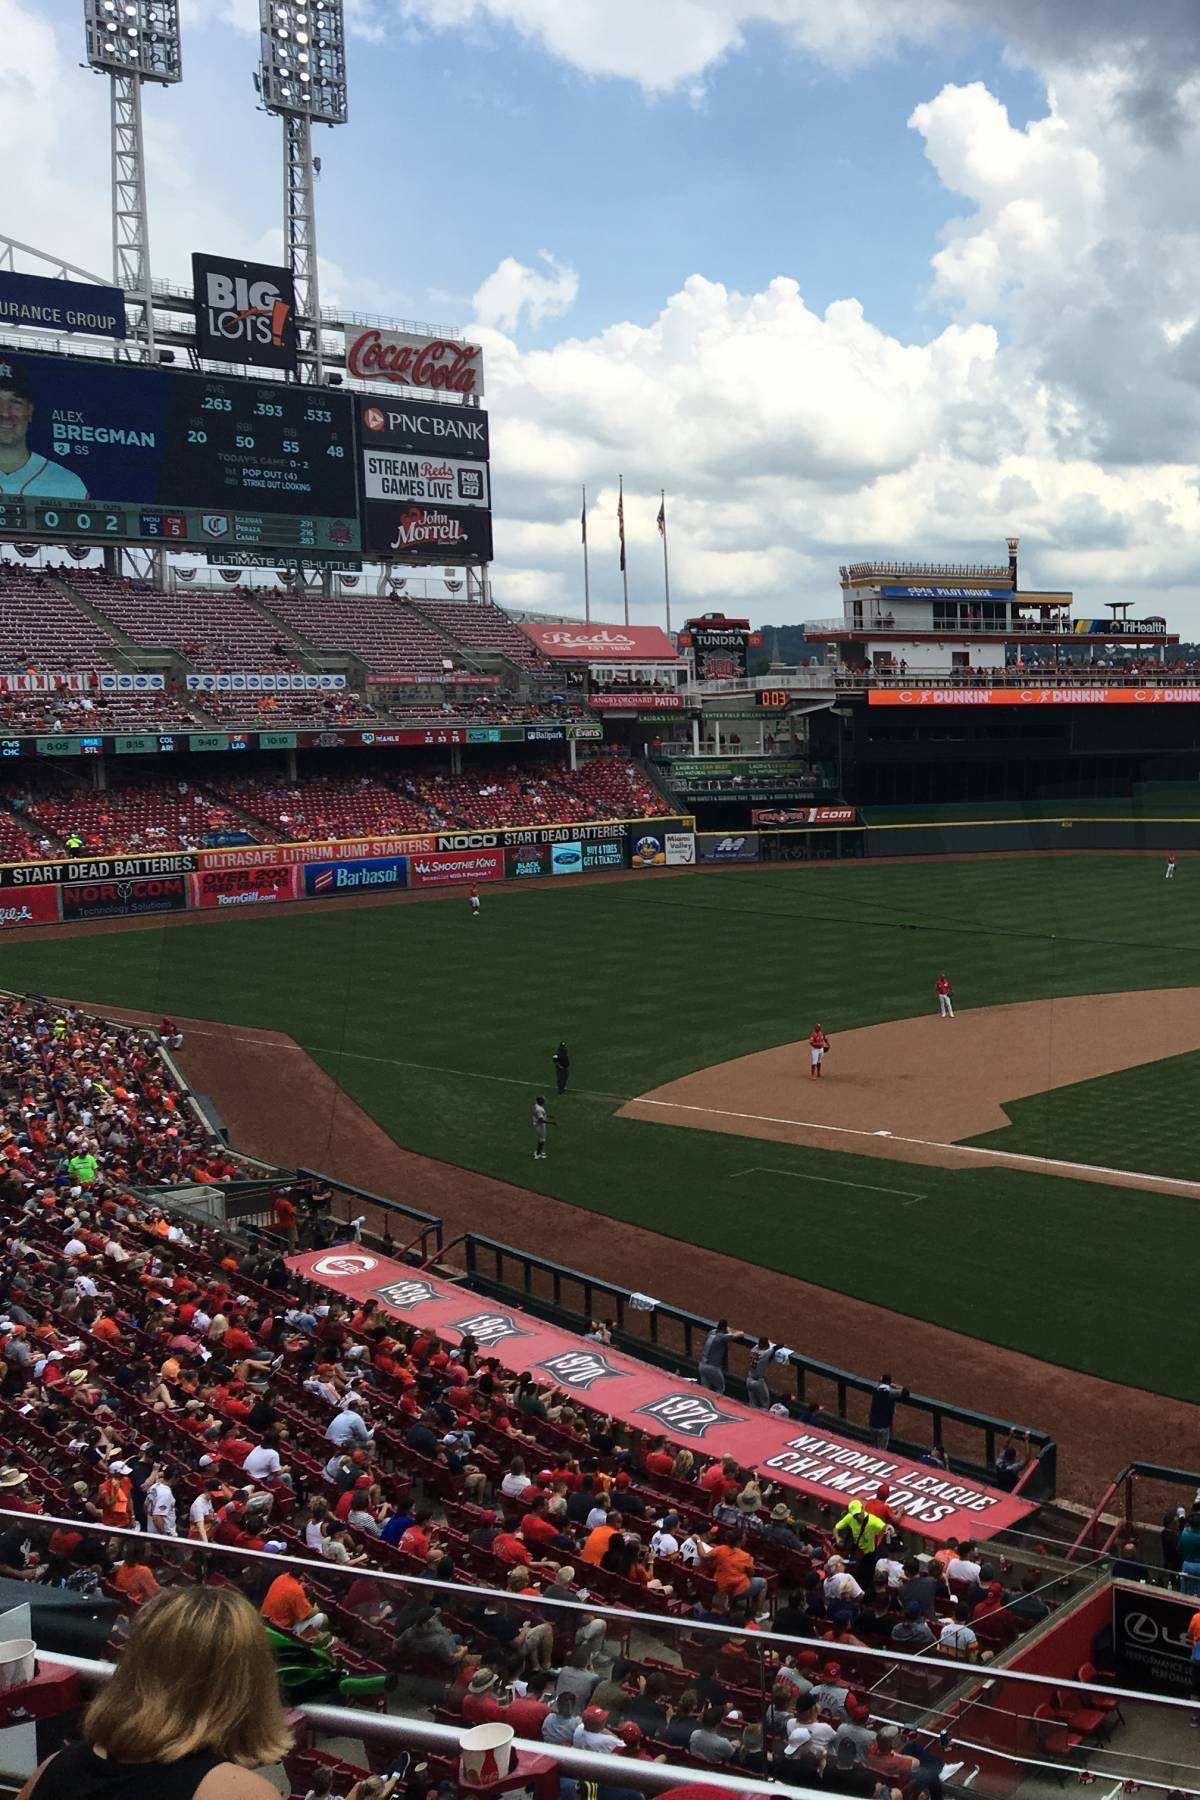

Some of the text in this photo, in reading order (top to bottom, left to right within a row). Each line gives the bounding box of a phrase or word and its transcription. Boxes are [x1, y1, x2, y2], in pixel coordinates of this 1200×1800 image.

[206, 272, 281, 312] BIG
[66, 311, 117, 330] GROUP
[350, 330, 482, 393] Coca-Cola
[206, 384, 326, 406] AVG OBP SLG
[51, 409, 85, 423] ALEX
[201, 398, 332, 423] .263 .393 .533
[237, 423, 252, 431] RBI
[53, 423, 155, 448] BREGMAN
[74, 445, 89, 455] SS
[187, 431, 344, 457] 20 50 55 48
[242, 468, 281, 480] POP OUT
[368, 458, 419, 478] STREAM
[421, 461, 455, 480] Reds
[461, 471, 479, 482] FOX
[242, 478, 312, 492] STRIKE OUT LOOKING
[382, 477, 453, 499] GAMES LIVE
[462, 486, 479, 496] GO
[44, 511, 118, 531] 0 0 2
[143, 516, 181, 526] HOU CIN
[418, 510, 447, 525] John
[390, 519, 468, 549] Morrell
[212, 554, 357, 571] ULTIMATE AIR SHUTTLE
[936, 587, 961, 596] PILOT
[963, 588, 992, 597] HOUSE
[1121, 622, 1165, 633] TriHealth
[542, 630, 636, 648] Reds
[697, 636, 745, 646] TUNDRA
[619, 696, 679, 706] ORCHARD PATIO
[933, 690, 992, 702] DUNKIN'
[1053, 690, 1108, 702] DUNKIN'
[536, 731, 563, 740] Ballpark
[576, 729, 600, 737] Evans
[267, 737, 288, 745] 10:10
[438, 835, 497, 850] NOCO
[504, 831, 538, 846] START
[541, 828, 570, 843] DEAD
[669, 842, 692, 850] Valley
[204, 839, 433, 868] ULTRASAFE LITHIUM JUMP STARTERS.
[557, 855, 577, 864] Ford
[13, 856, 196, 884] START DEAD BATTERIES.
[431, 858, 497, 872] SMOOTHIE KING
[516, 866, 542, 875] FOREST
[517, 861, 539, 869] BLACK
[255, 868, 288, 880] 200
[336, 864, 399, 887] Barbasol
[79, 901, 172, 917] Technology Solutions
[332, 1261, 366, 1273] REDS
[380, 1281, 433, 1305] 1939
[458, 1315, 514, 1341] 1961
[545, 1352, 606, 1383] 1970
[657, 1397, 719, 1429] 1972
[787, 1434, 998, 1511] NATIONAL LEAGUE
[765, 1452, 956, 1523] CHAMPONS
[1126, 1651, 1184, 1675] PERFORMANCE
